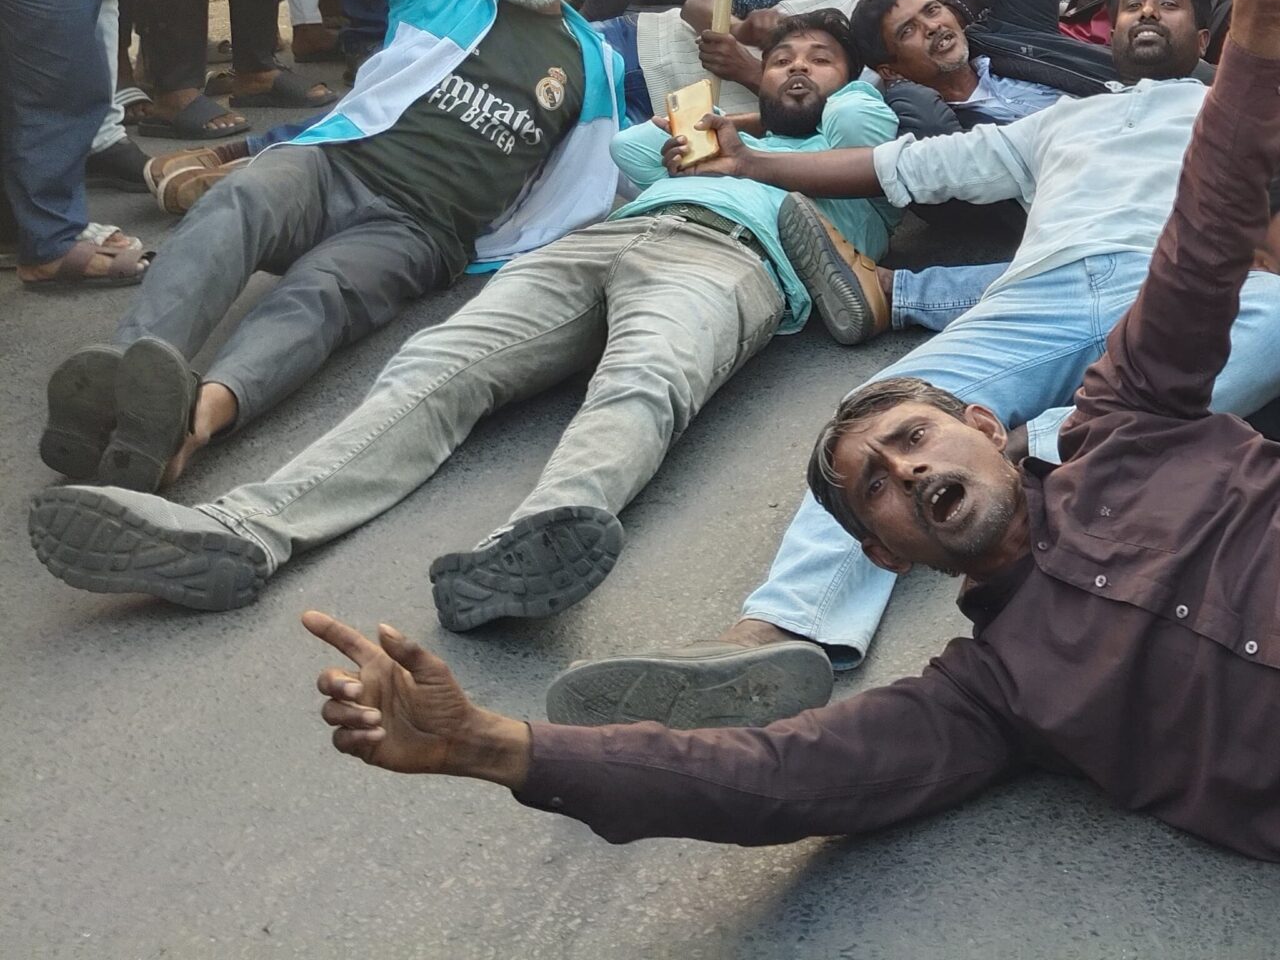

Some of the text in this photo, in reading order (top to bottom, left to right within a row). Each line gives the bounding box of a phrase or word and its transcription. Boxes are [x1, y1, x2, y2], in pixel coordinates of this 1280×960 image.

[428, 88, 515, 155] FLY BETTER
[440, 73, 544, 145] mirates
